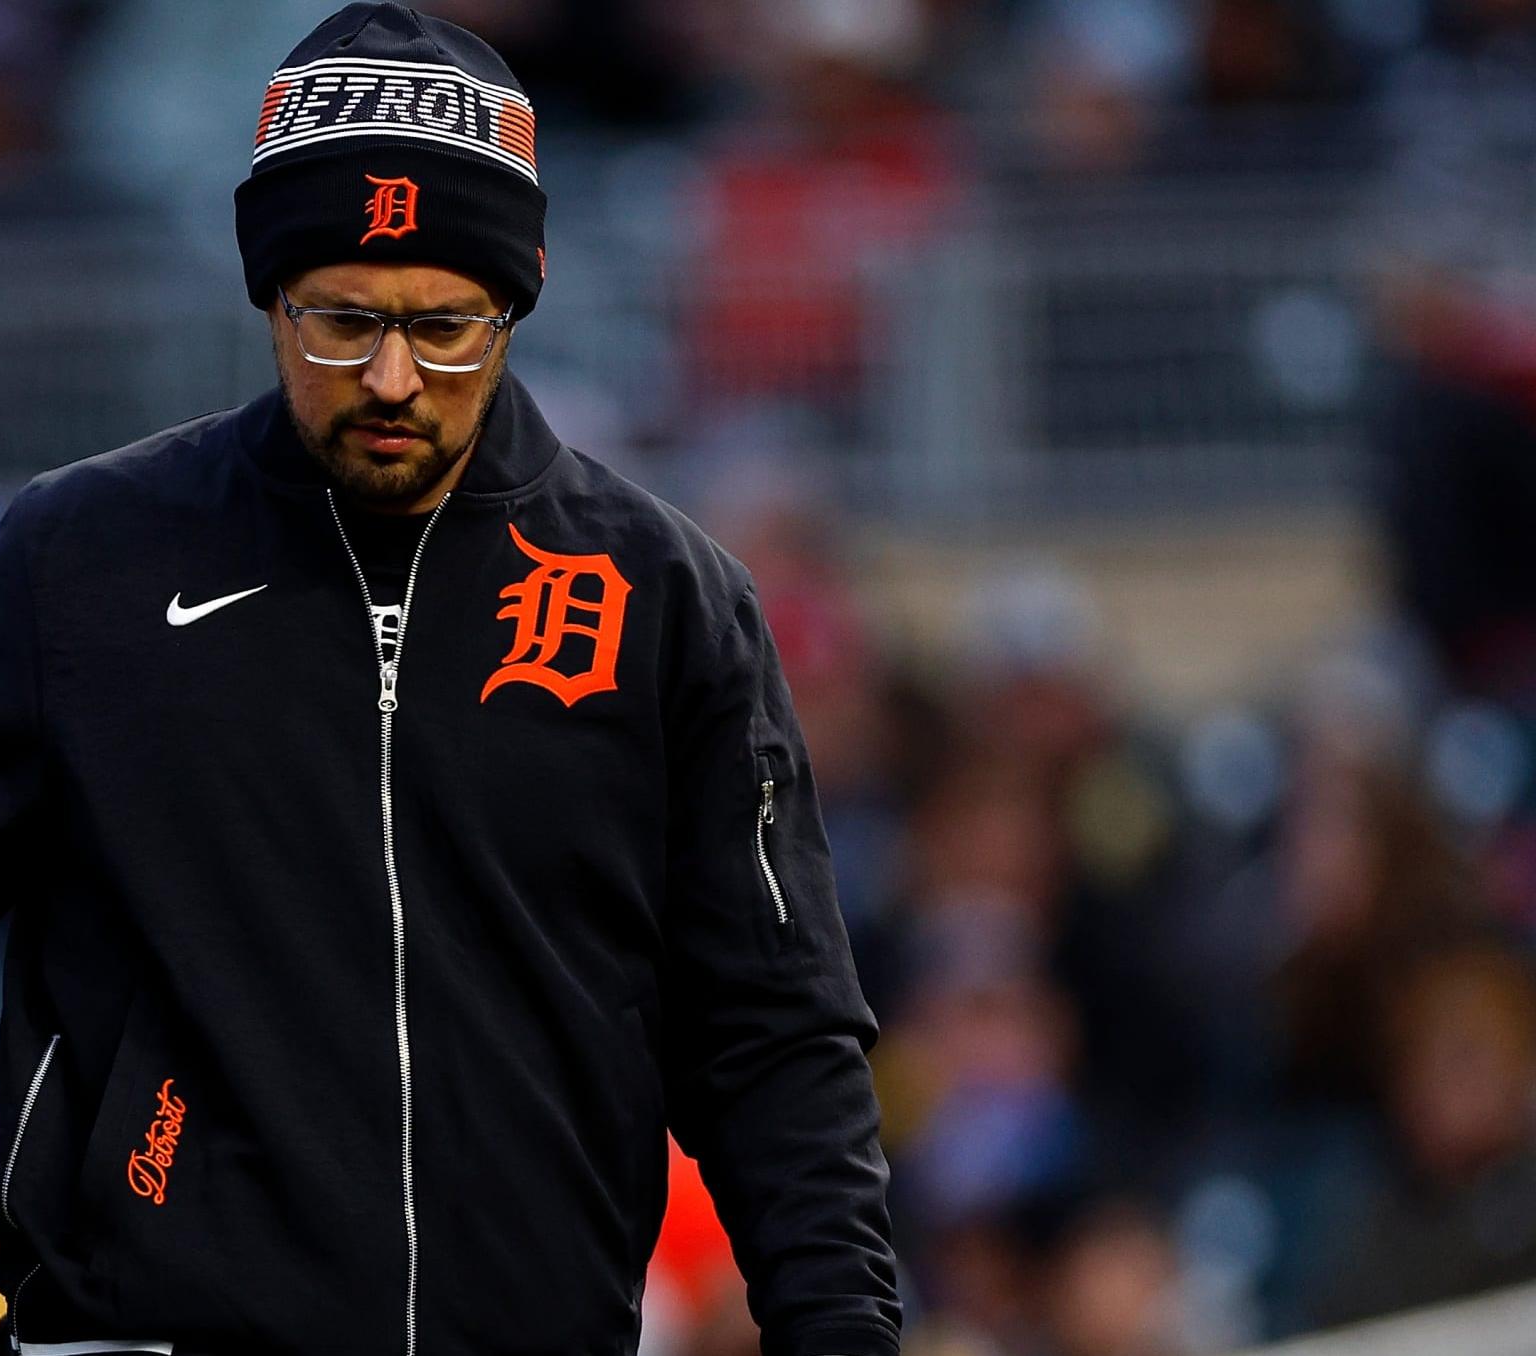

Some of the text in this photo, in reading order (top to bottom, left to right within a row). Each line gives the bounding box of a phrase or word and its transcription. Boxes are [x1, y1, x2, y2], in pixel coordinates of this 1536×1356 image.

[265, 77, 504, 147] DETROIT
[360, 174, 420, 246] D
[480, 522, 633, 708] D
[128, 1078, 187, 1205] Detroit
